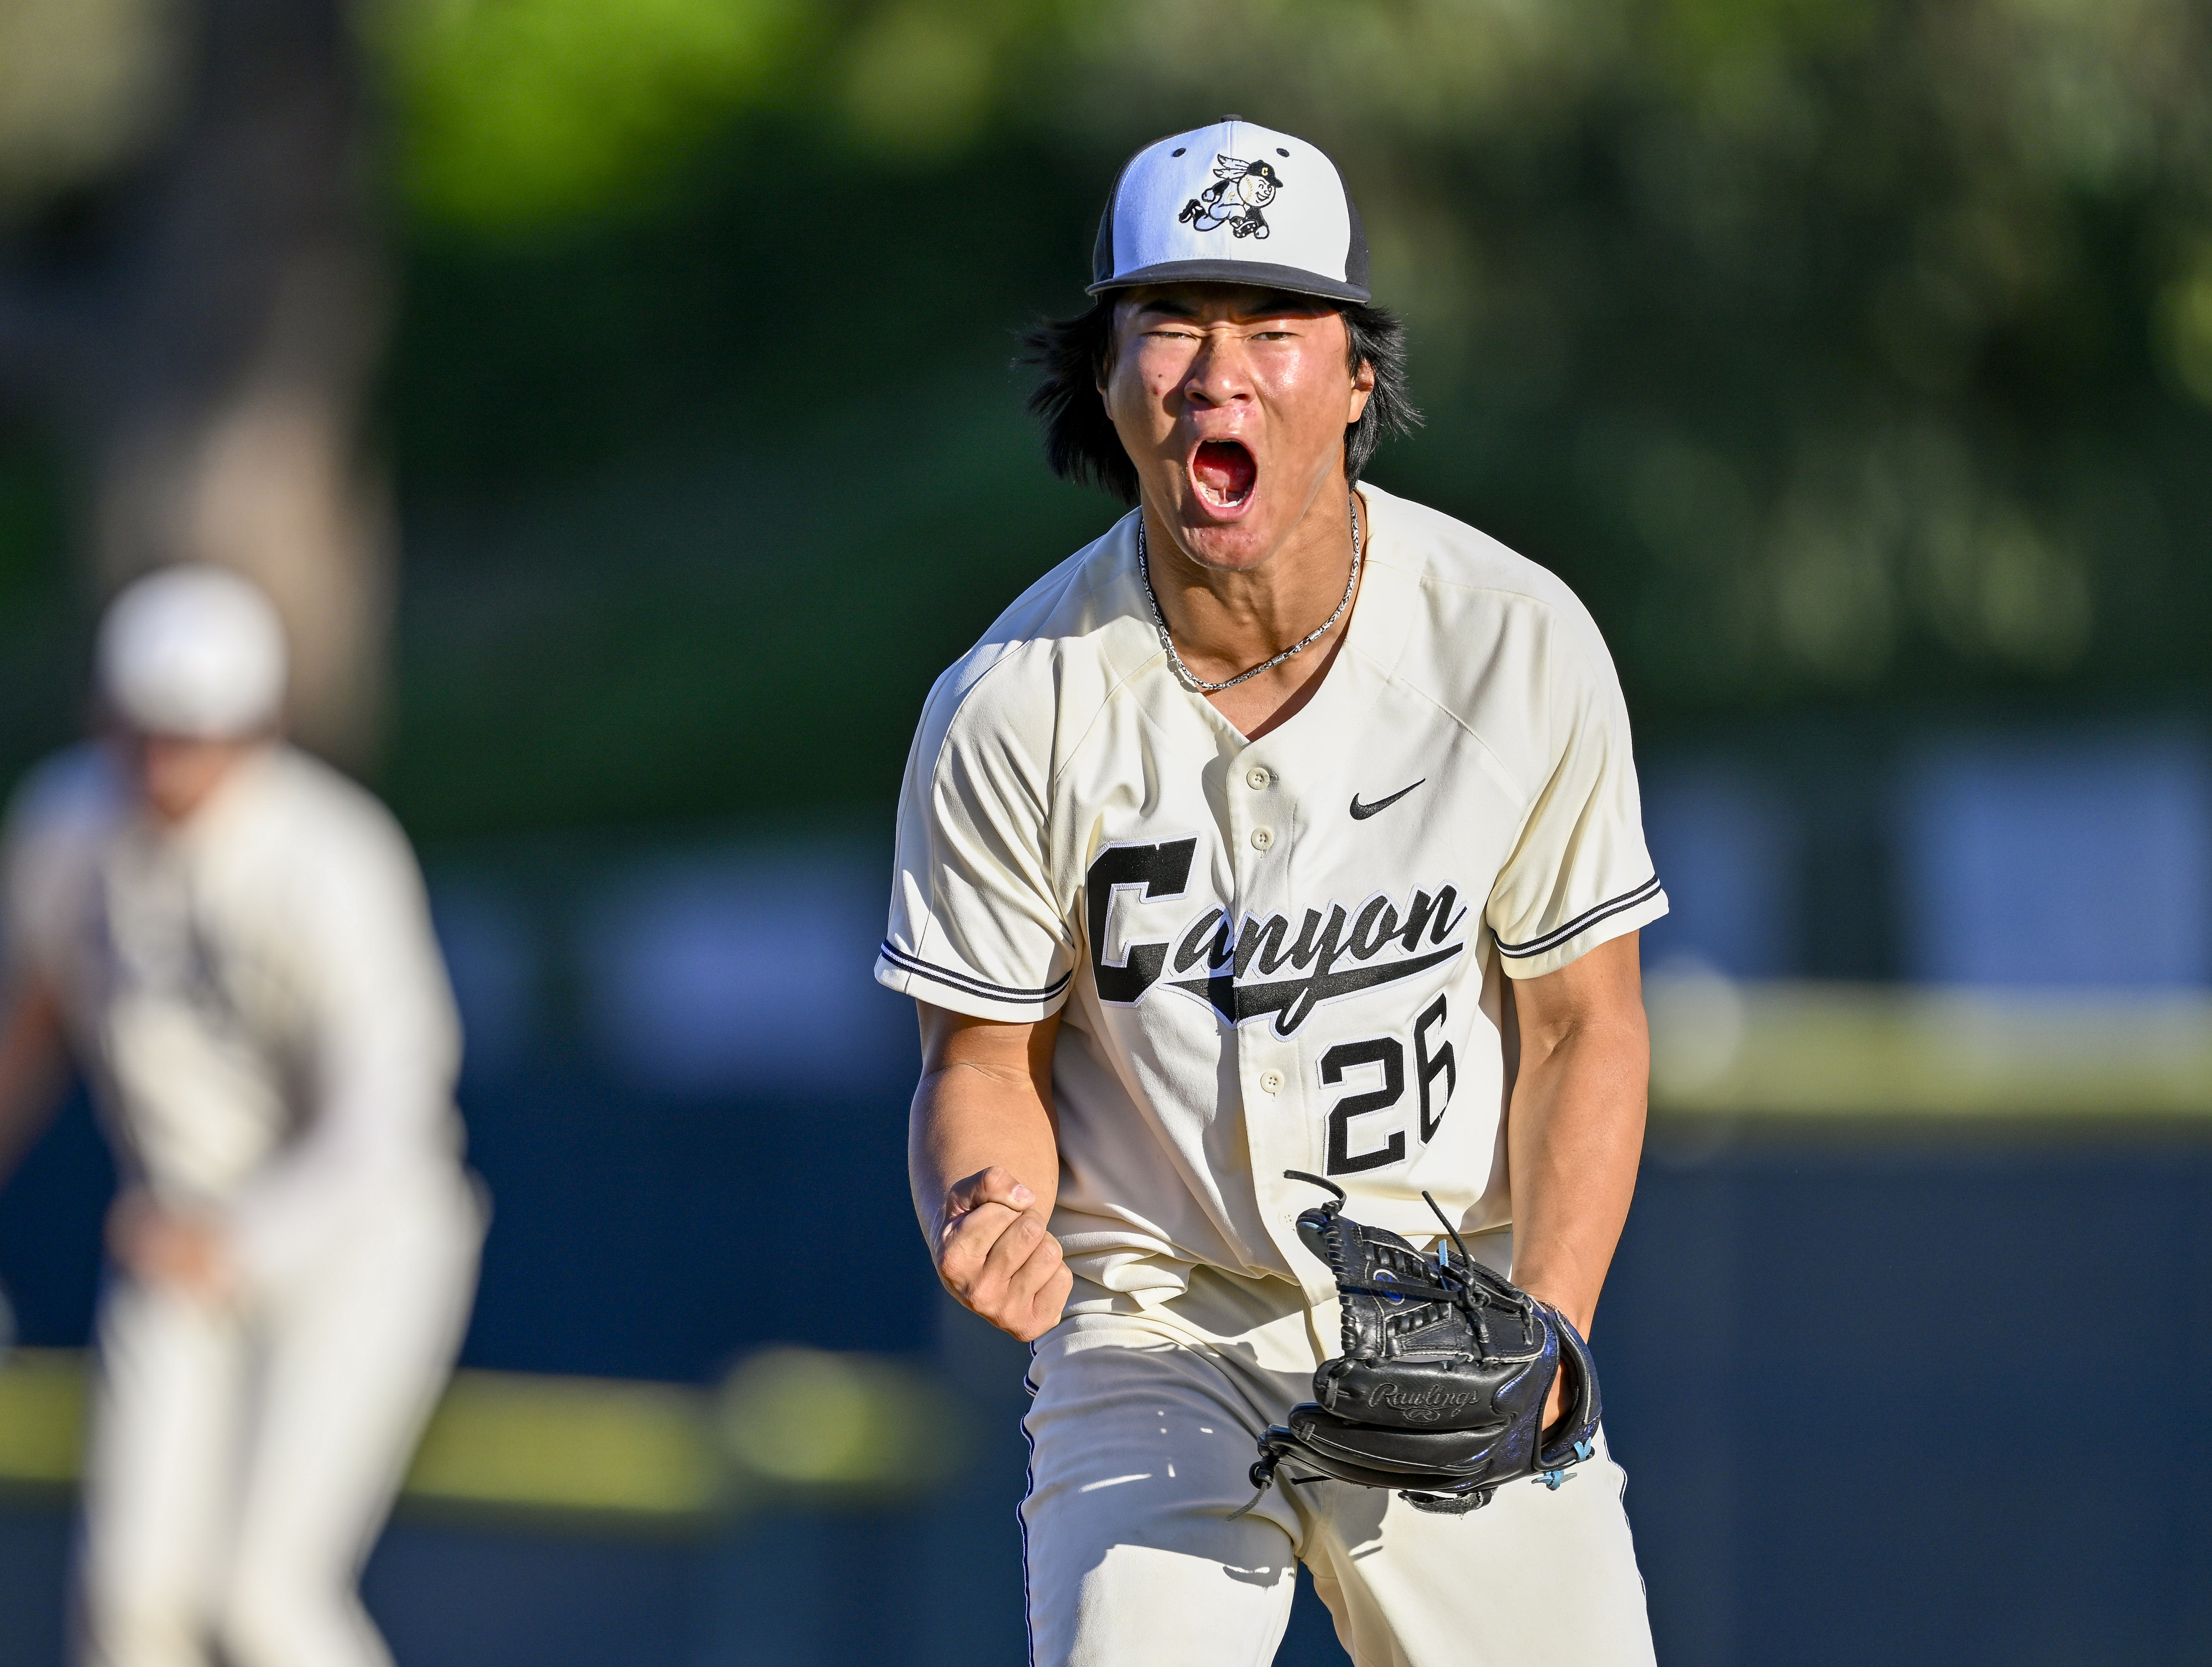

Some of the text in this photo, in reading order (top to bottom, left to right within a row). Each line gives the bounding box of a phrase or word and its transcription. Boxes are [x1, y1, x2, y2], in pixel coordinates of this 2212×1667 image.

[1087, 835, 1468, 1038] Canyon
[1319, 993, 1457, 1176] 26
[1368, 1383, 1480, 1418] Rawlings
